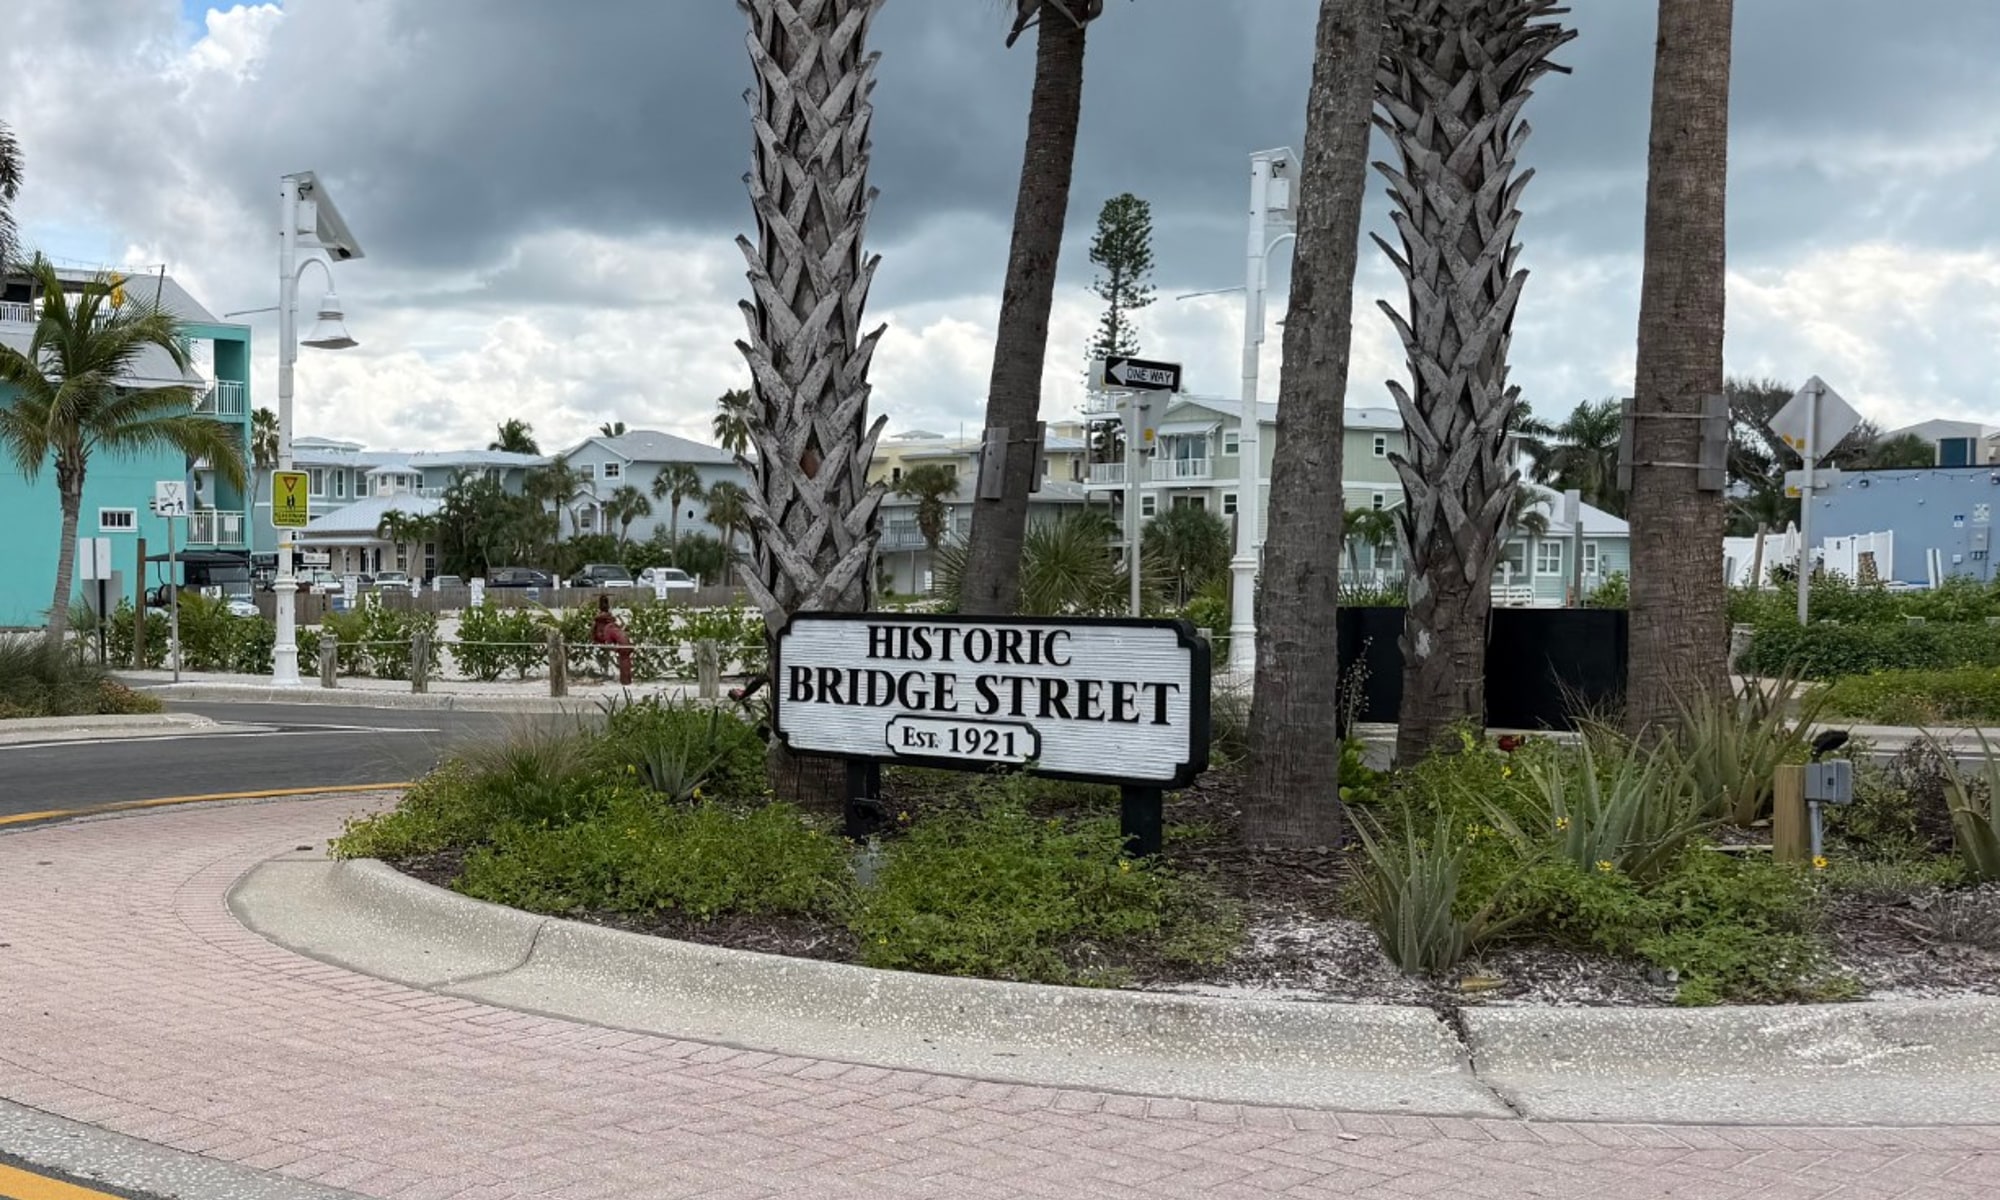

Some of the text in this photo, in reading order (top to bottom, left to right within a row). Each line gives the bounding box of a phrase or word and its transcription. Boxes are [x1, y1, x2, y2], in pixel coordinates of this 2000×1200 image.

[1127, 367, 1171, 384] ONE WAY
[866, 625, 1072, 667] HISTORIC
[787, 665, 1180, 726] BRIDGE STREET
[948, 728, 1018, 757] 1921
